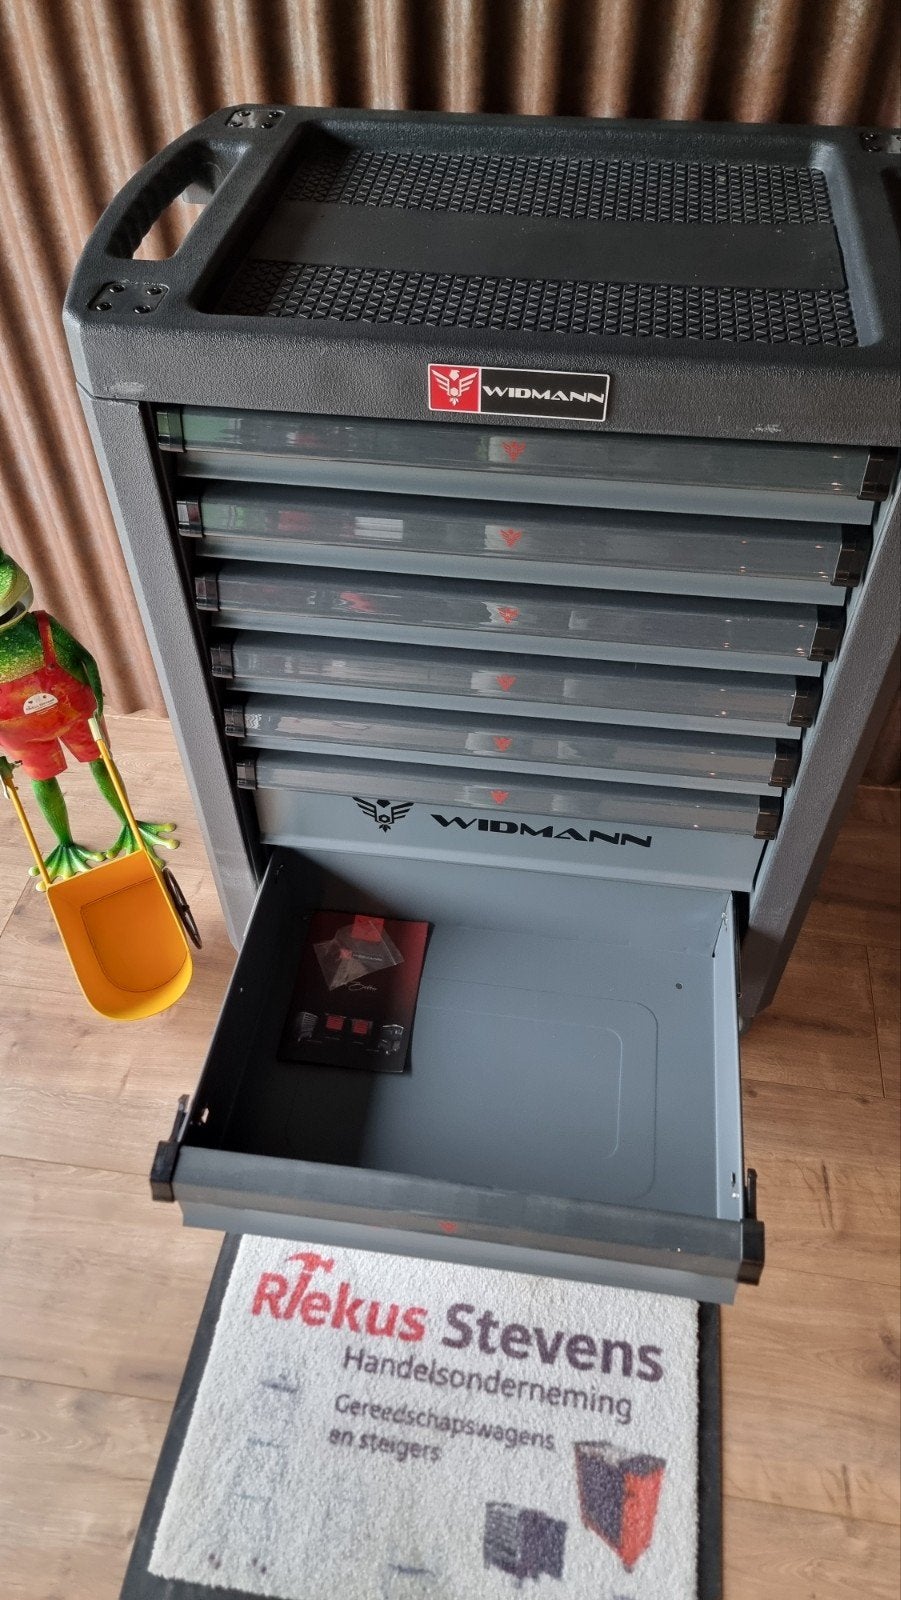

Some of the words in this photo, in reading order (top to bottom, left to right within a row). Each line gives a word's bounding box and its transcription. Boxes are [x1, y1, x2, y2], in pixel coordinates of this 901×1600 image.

[482, 386, 604, 403] WIDMANN
[431, 814, 652, 847] WIDMANN
[252, 1253, 428, 1342] Riekus
[442, 1302, 664, 1382] Stevens
[343, 1346, 632, 1425] Handelsonderneming
[334, 1394, 555, 1449] Gereedschapswagens
[329, 1428, 354, 1445] en
[359, 1432, 441, 1462] steigers
